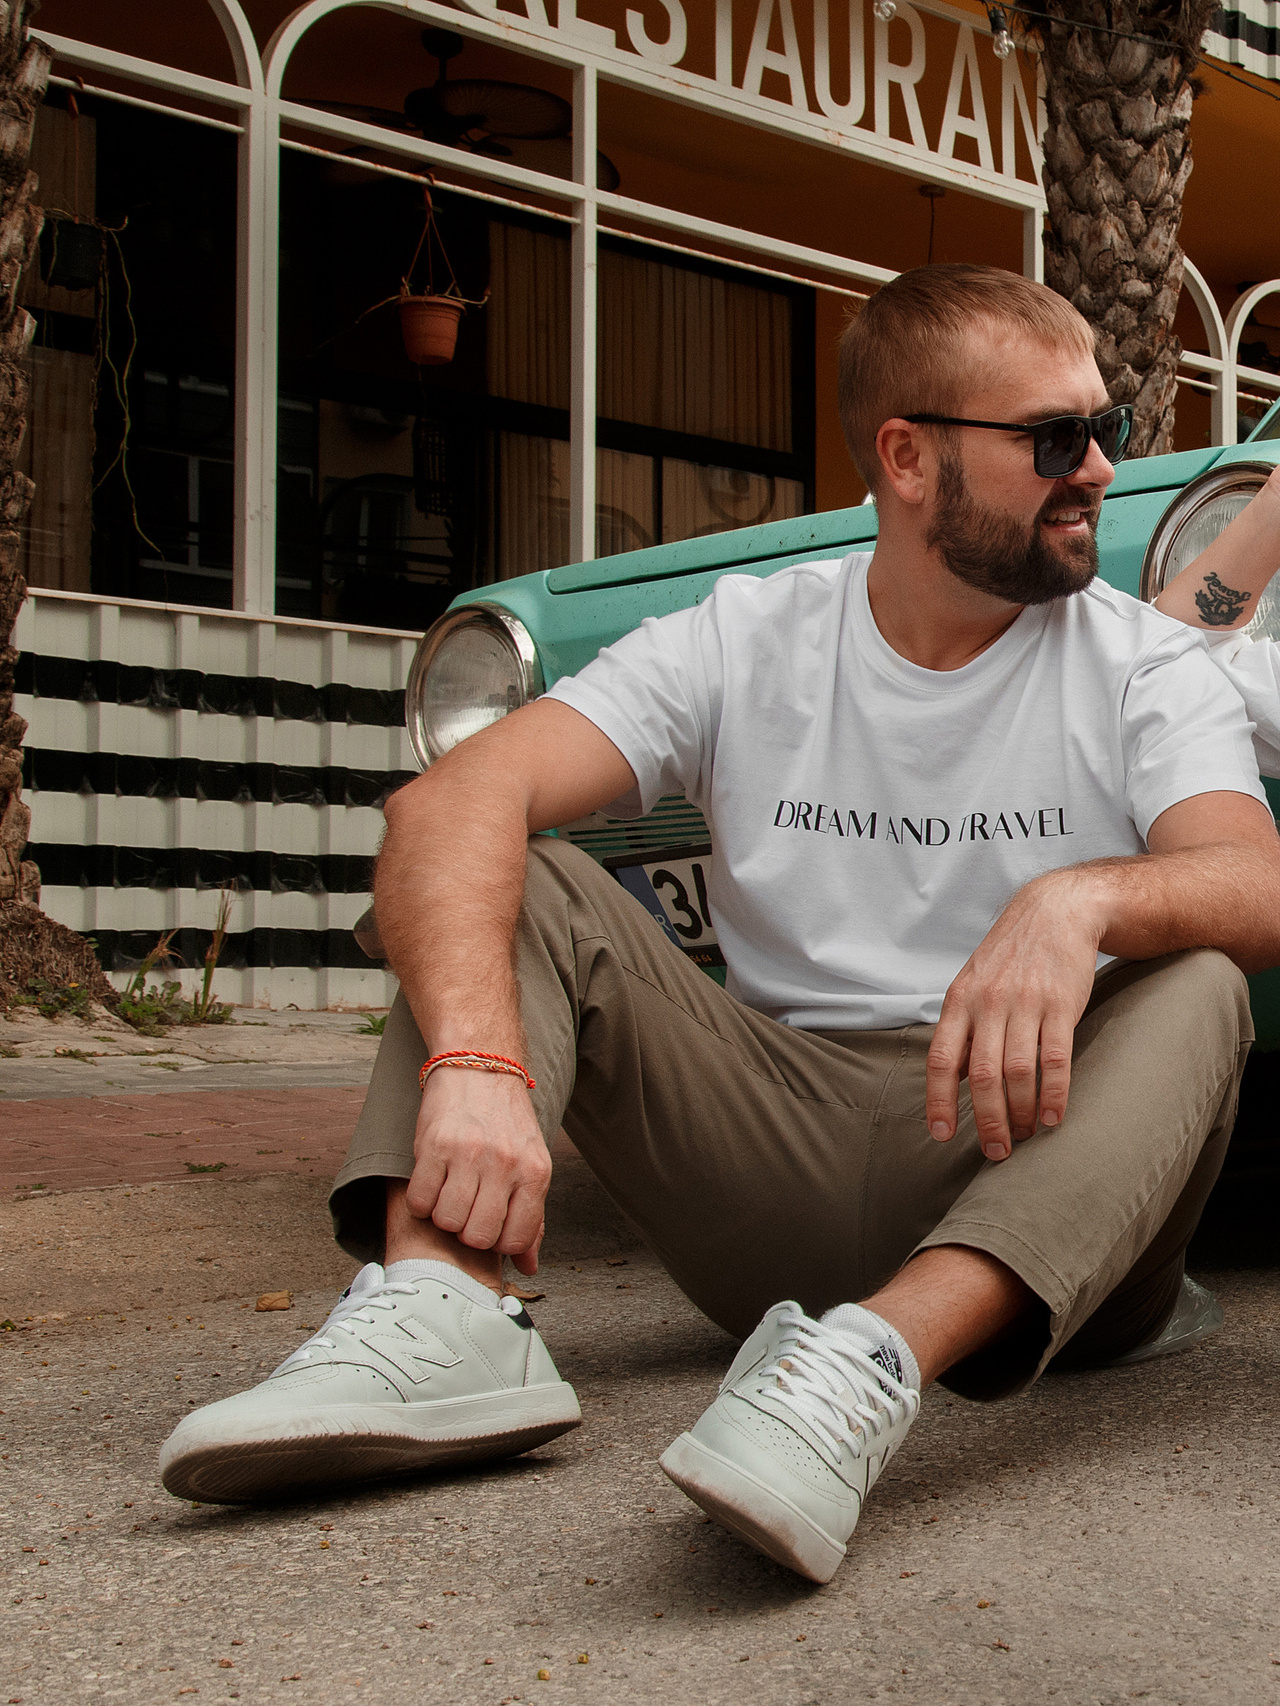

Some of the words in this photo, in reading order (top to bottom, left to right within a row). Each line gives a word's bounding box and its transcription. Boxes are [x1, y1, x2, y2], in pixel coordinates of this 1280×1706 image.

[472, 0, 1044, 186] TAURAN
[774, 800, 877, 838] DREAM
[886, 815, 951, 846] AND
[958, 807, 1074, 842] TRAVEL
